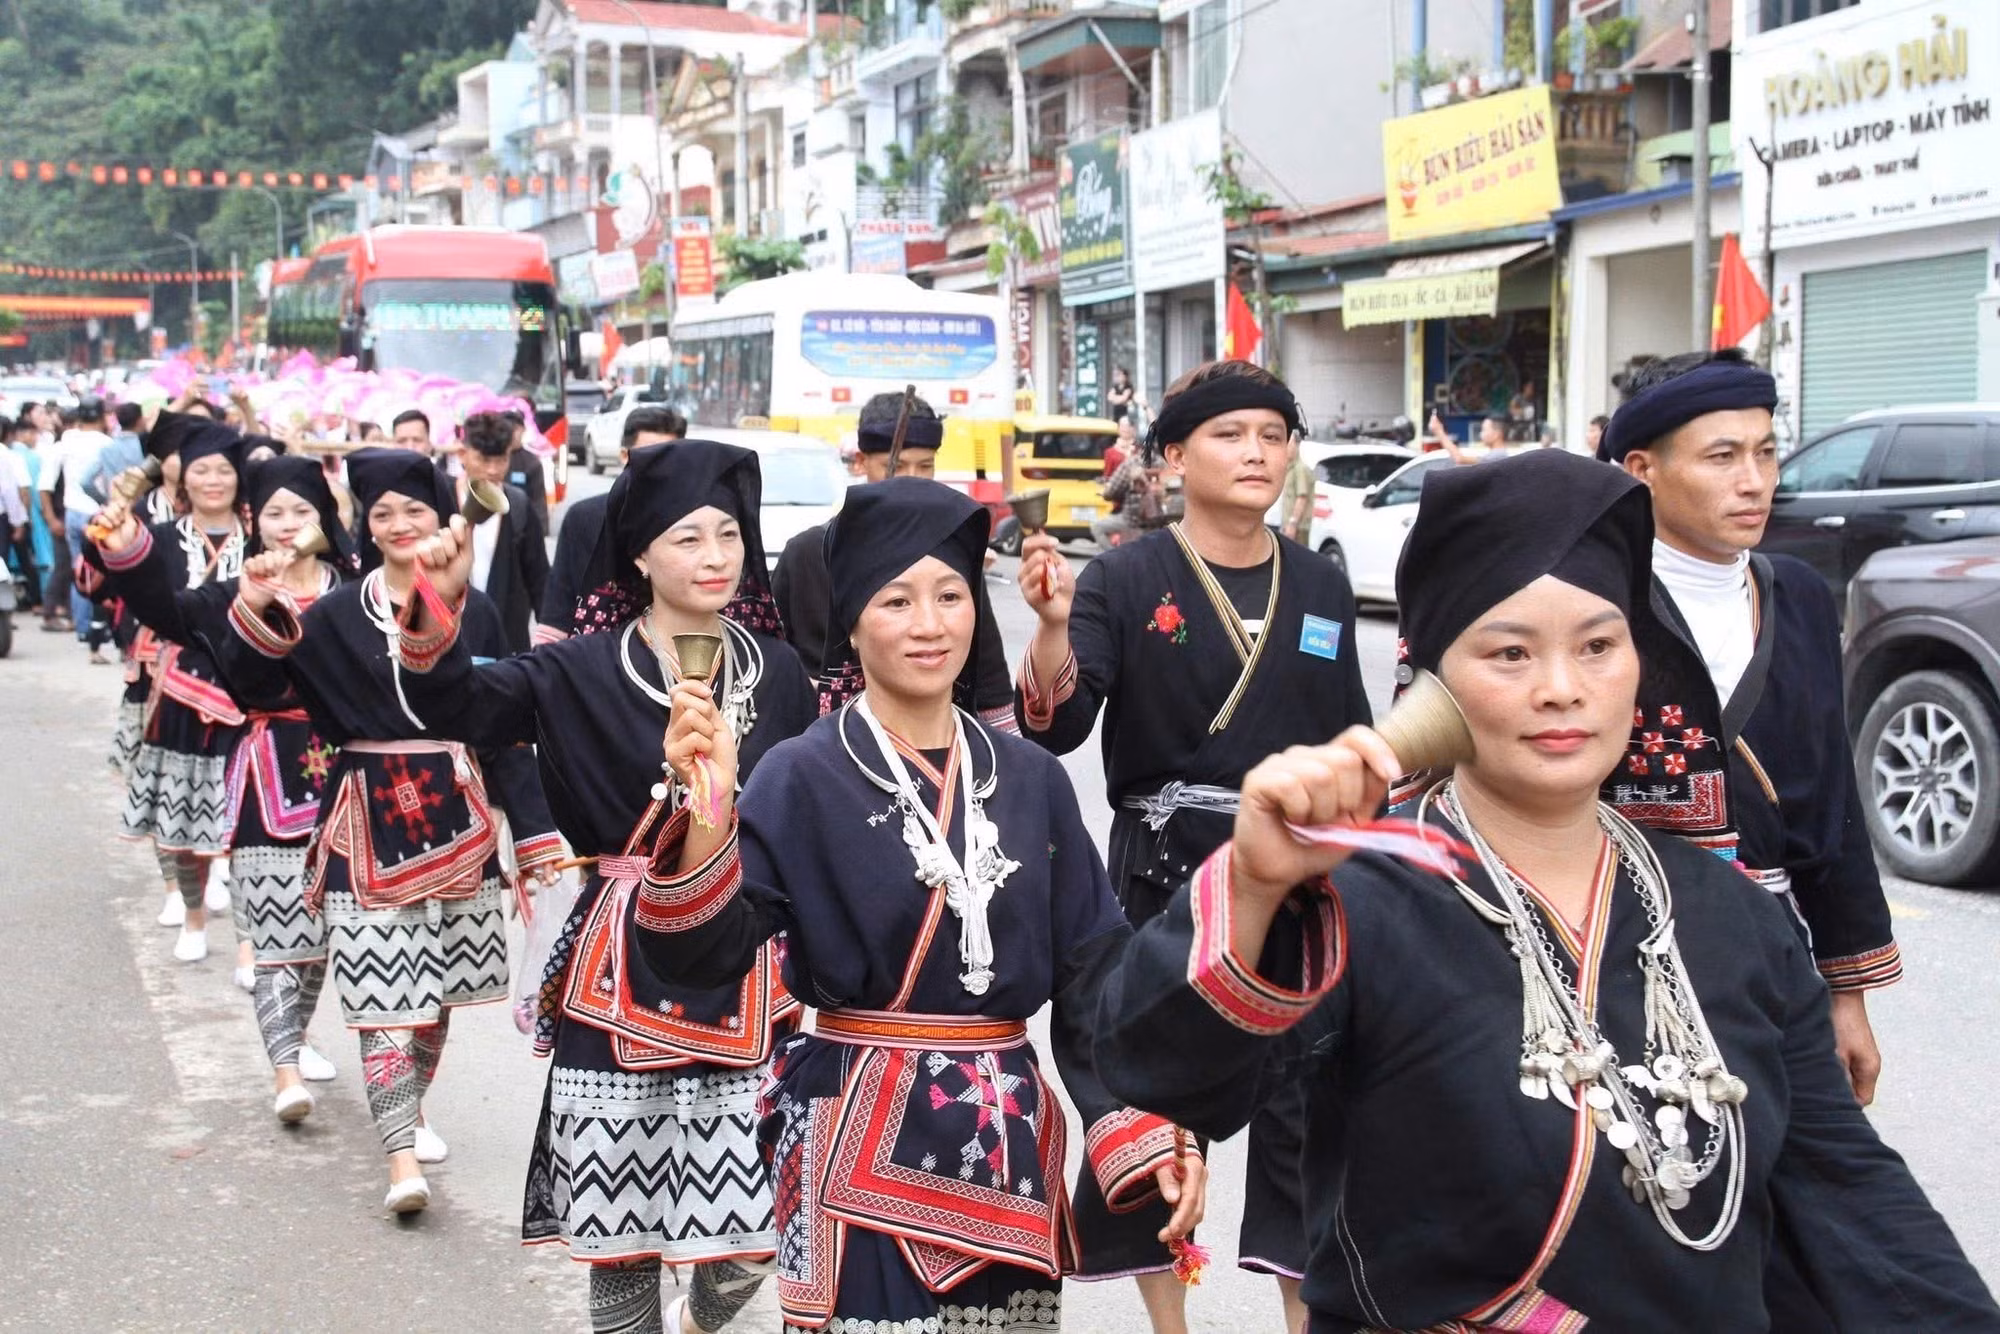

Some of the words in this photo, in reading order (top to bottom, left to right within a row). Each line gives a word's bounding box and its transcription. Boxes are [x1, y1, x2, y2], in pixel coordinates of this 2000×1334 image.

[1764, 48, 1890, 118] HOÀNG
[1897, 14, 1968, 93] HẢI
[1760, 136, 1822, 164] CAMERA
[1833, 119, 1895, 151] LAPTOP
[1909, 101, 1946, 135] MÁY
[1952, 94, 1991, 126] TÍNH
